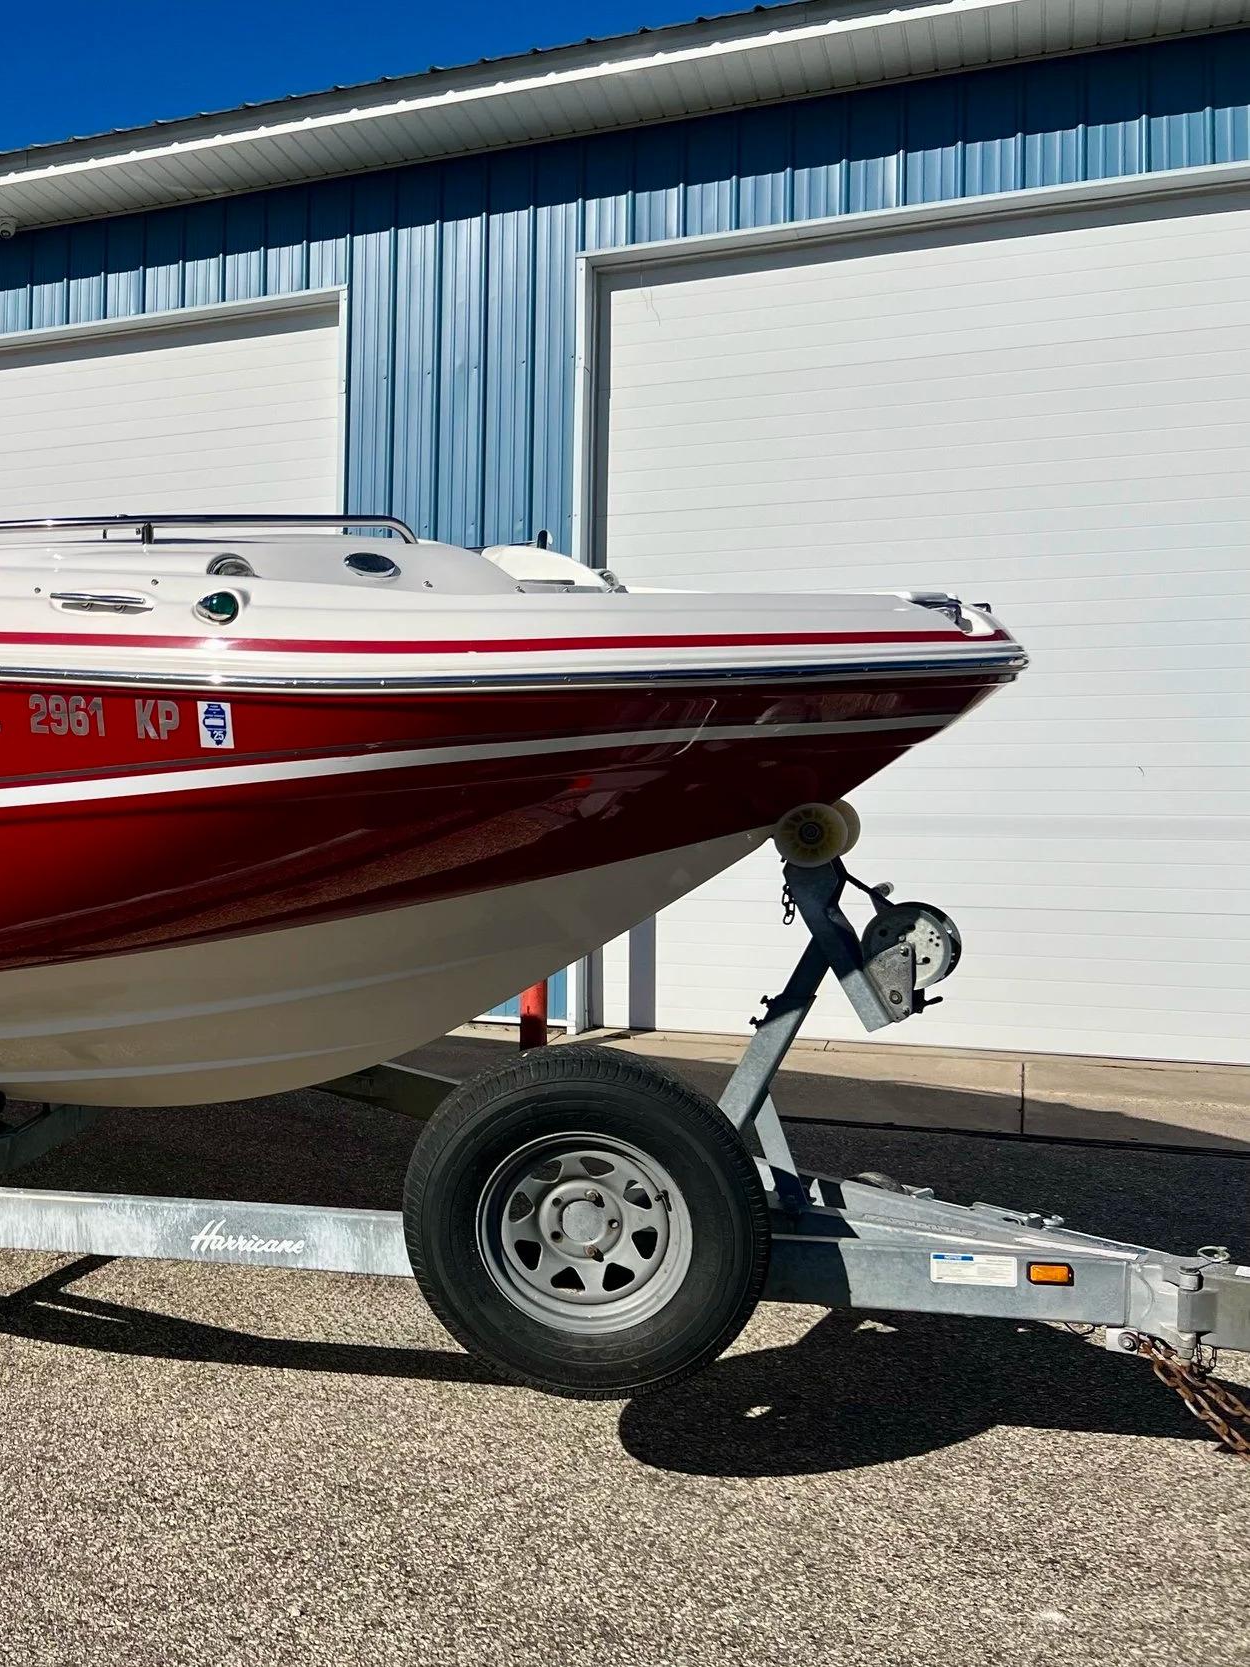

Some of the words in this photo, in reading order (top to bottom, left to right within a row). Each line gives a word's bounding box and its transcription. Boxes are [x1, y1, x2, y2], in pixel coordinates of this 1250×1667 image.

[28, 694, 105, 737] 2961
[135, 699, 179, 740] KP
[213, 730, 225, 741] 25
[190, 1218, 305, 1254] Hurricane
